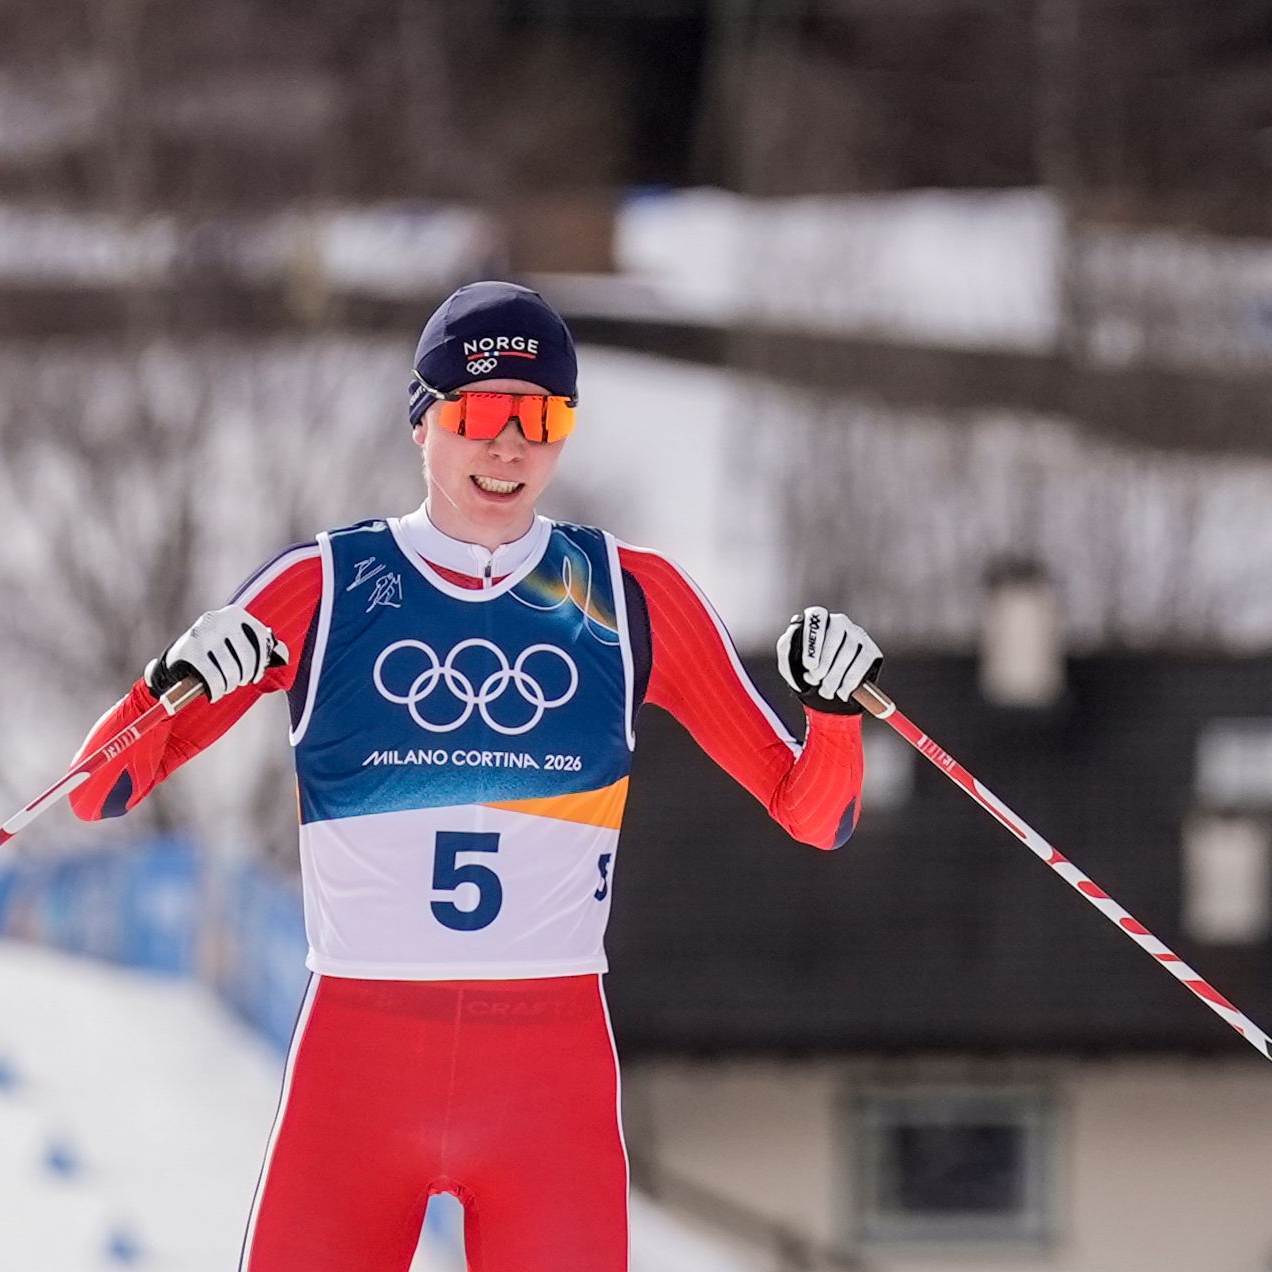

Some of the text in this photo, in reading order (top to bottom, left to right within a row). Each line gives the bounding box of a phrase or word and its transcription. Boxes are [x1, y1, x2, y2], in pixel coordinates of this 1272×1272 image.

[463, 336, 539, 355] NORGE
[361, 749, 583, 772] MILANO CORTINA 2026
[430, 830, 503, 932] 5
